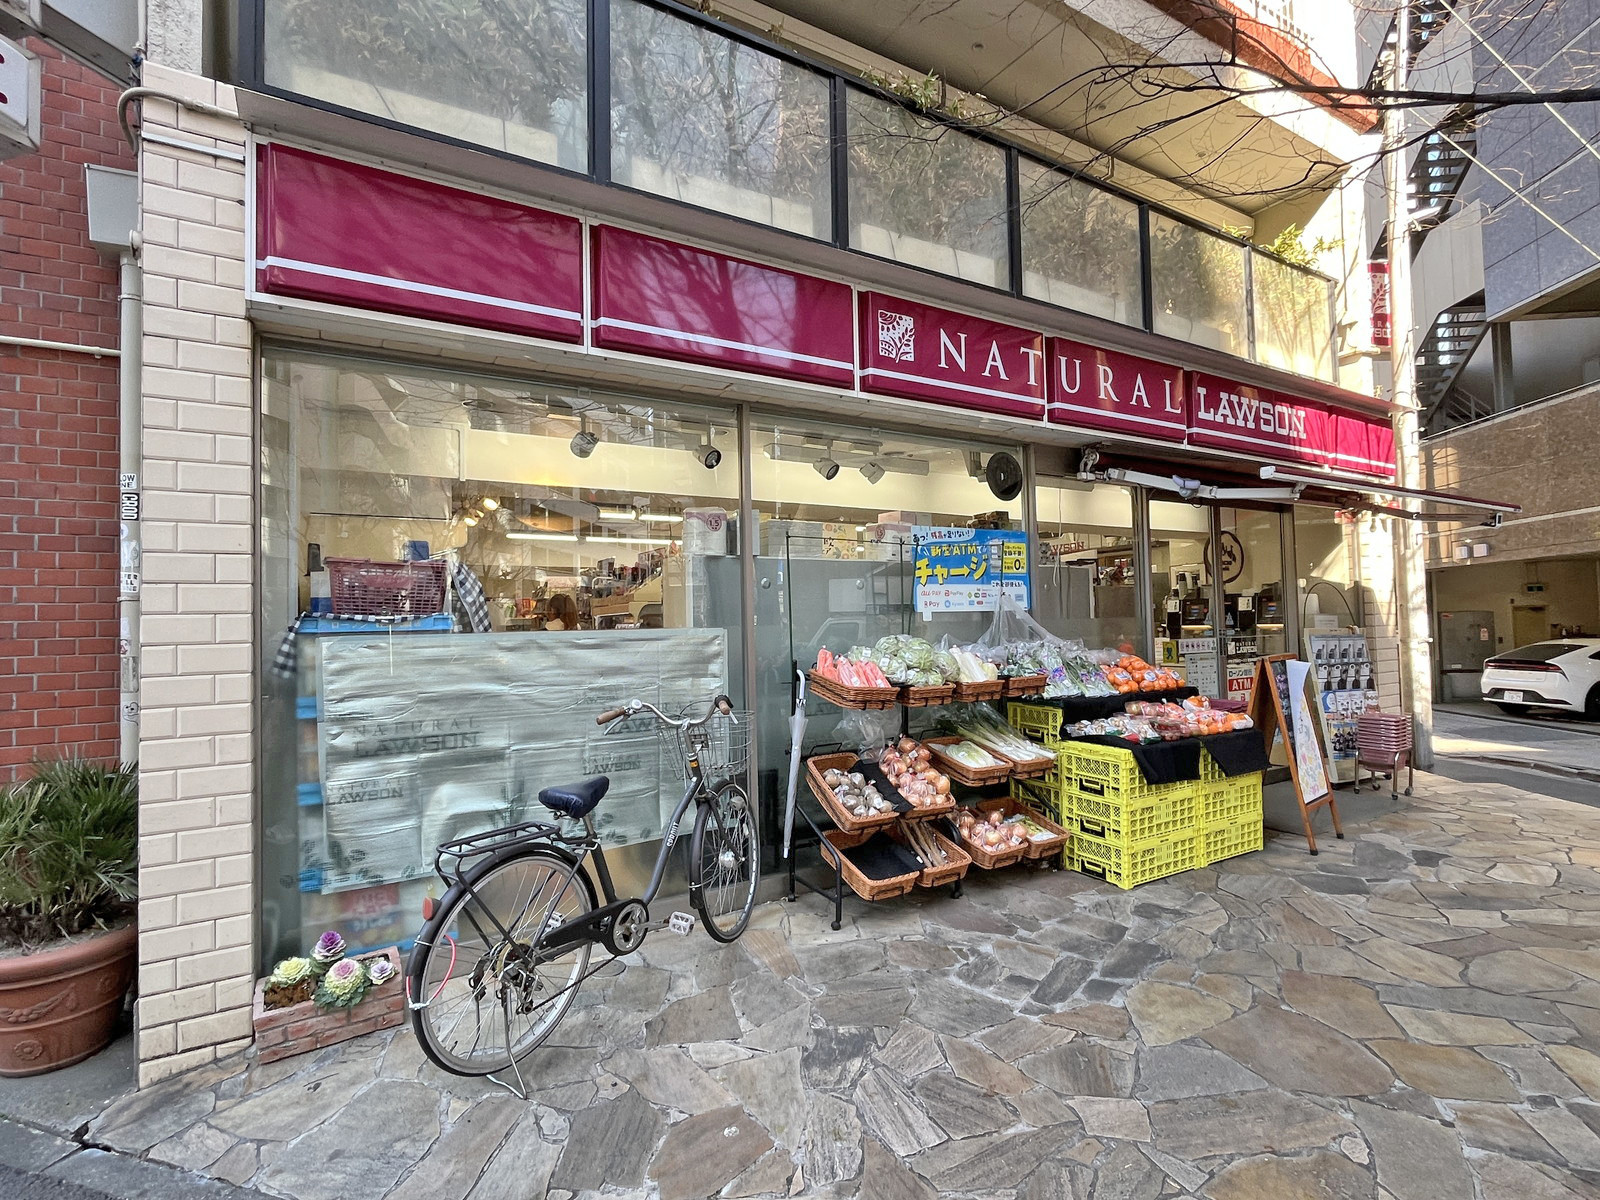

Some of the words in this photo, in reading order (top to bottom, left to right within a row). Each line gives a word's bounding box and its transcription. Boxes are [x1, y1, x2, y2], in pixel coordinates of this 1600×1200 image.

[937, 328, 1182, 414] NATURAL
[1197, 386, 1307, 439] LAWSON
[1232, 678, 1251, 691] ATM
[353, 732, 483, 758] LAWSON
